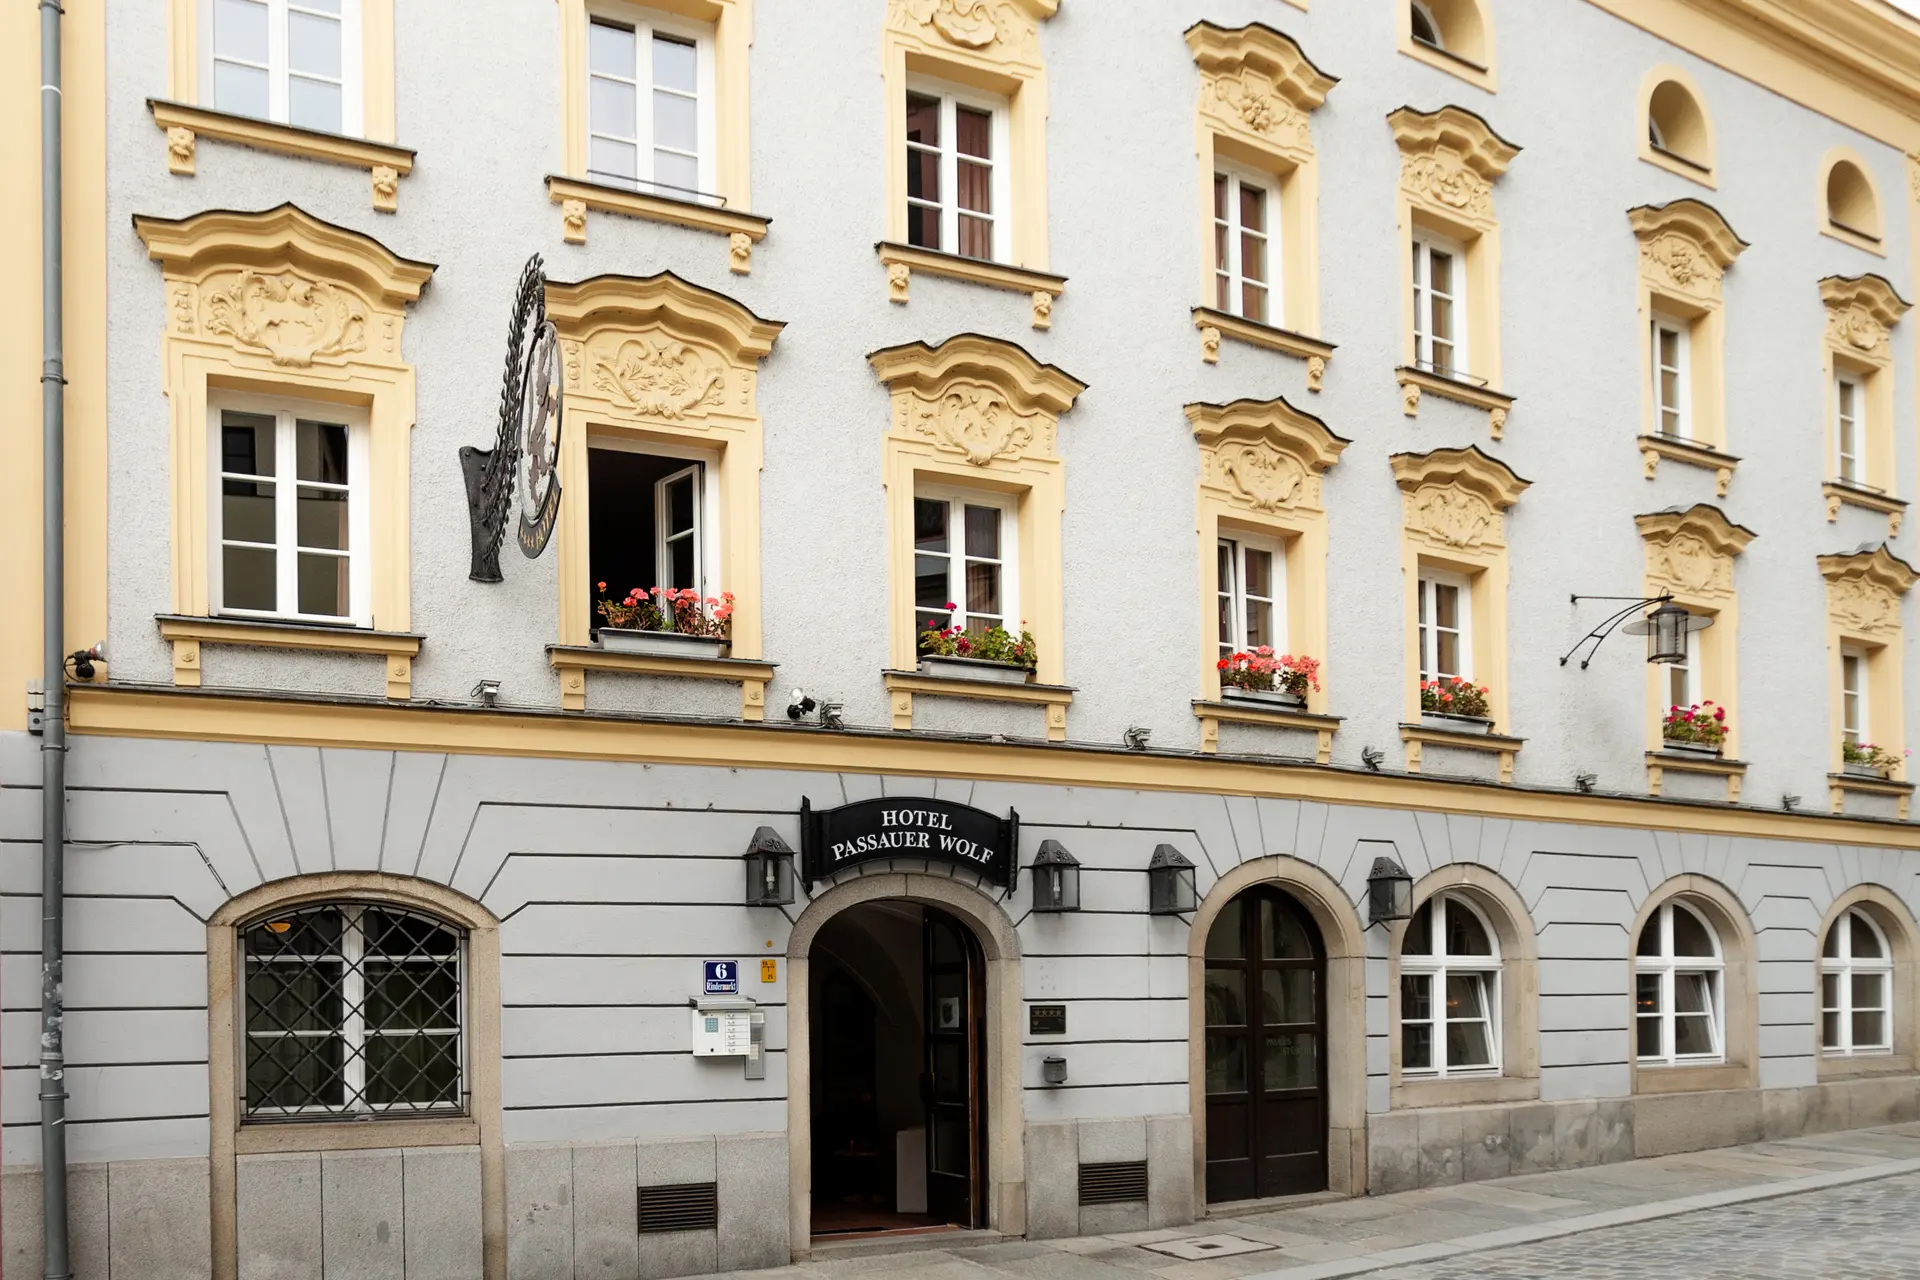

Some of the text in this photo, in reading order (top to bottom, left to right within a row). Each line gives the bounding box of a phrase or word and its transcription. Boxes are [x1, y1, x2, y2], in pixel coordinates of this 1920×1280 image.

[881, 809, 953, 831] HOTEL
[830, 831, 994, 864] PASSAUER WOLF
[715, 962, 728, 980] 6
[707, 981, 736, 991] Rindermarkt
